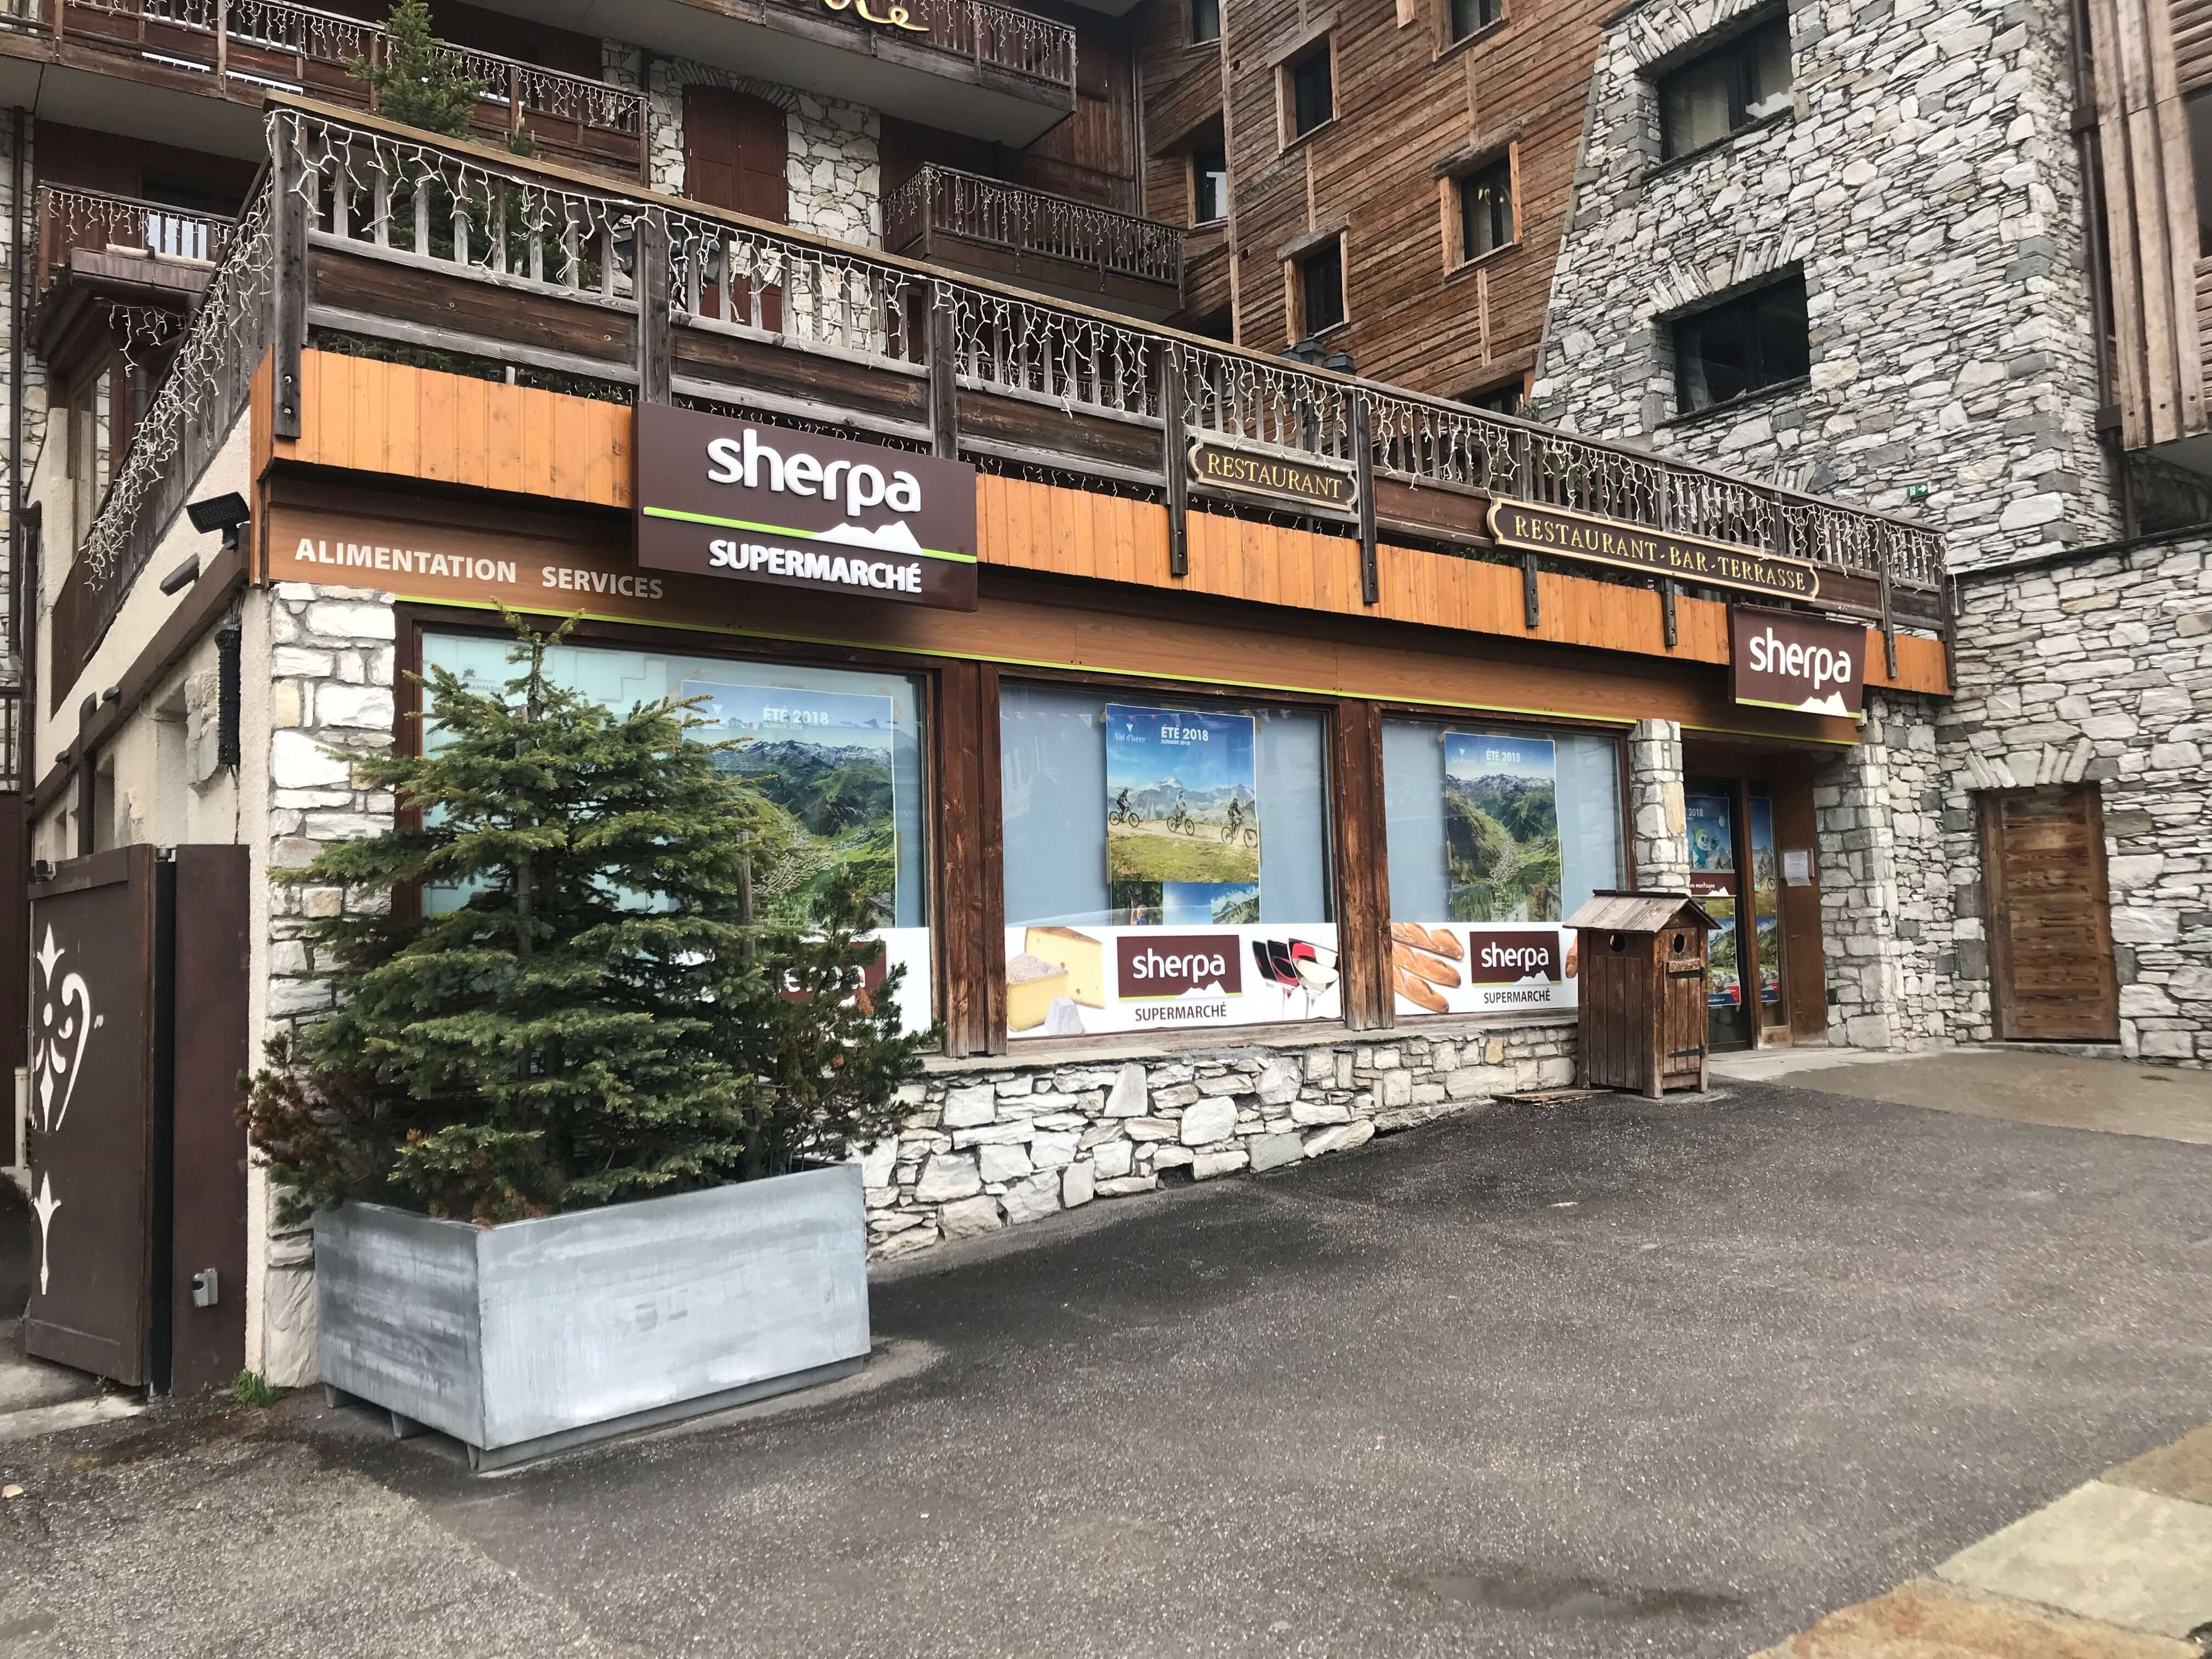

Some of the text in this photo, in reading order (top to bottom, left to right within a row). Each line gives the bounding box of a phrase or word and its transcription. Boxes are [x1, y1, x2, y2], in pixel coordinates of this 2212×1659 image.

[707, 428, 921, 517] sherpa
[1207, 453, 1342, 499] RESTAURANT
[709, 540, 922, 594] SUPERMARCHÉ
[1514, 515, 1806, 591] RESTAURANT BAR TERRASSE
[295, 538, 664, 600] ALIMENTATION SERVICES
[1749, 627, 1852, 690] sherpa
[763, 704, 829, 725] ÉTÉ 2018
[1114, 732, 1146, 743] Val d'Isère
[1161, 724, 1209, 741] ÉTÉ 2018
[1486, 748, 1500, 761] ÉTÉ
[1501, 751, 1521, 763] 2018
[1688, 808, 1703, 816] 2018
[1132, 948, 1226, 983] sherpa
[1481, 942, 1549, 972] sherpa
[1484, 988, 1550, 1004] SUPERMARCHÉ
[1135, 1002, 1227, 1022] SUPERMARCHÉ
